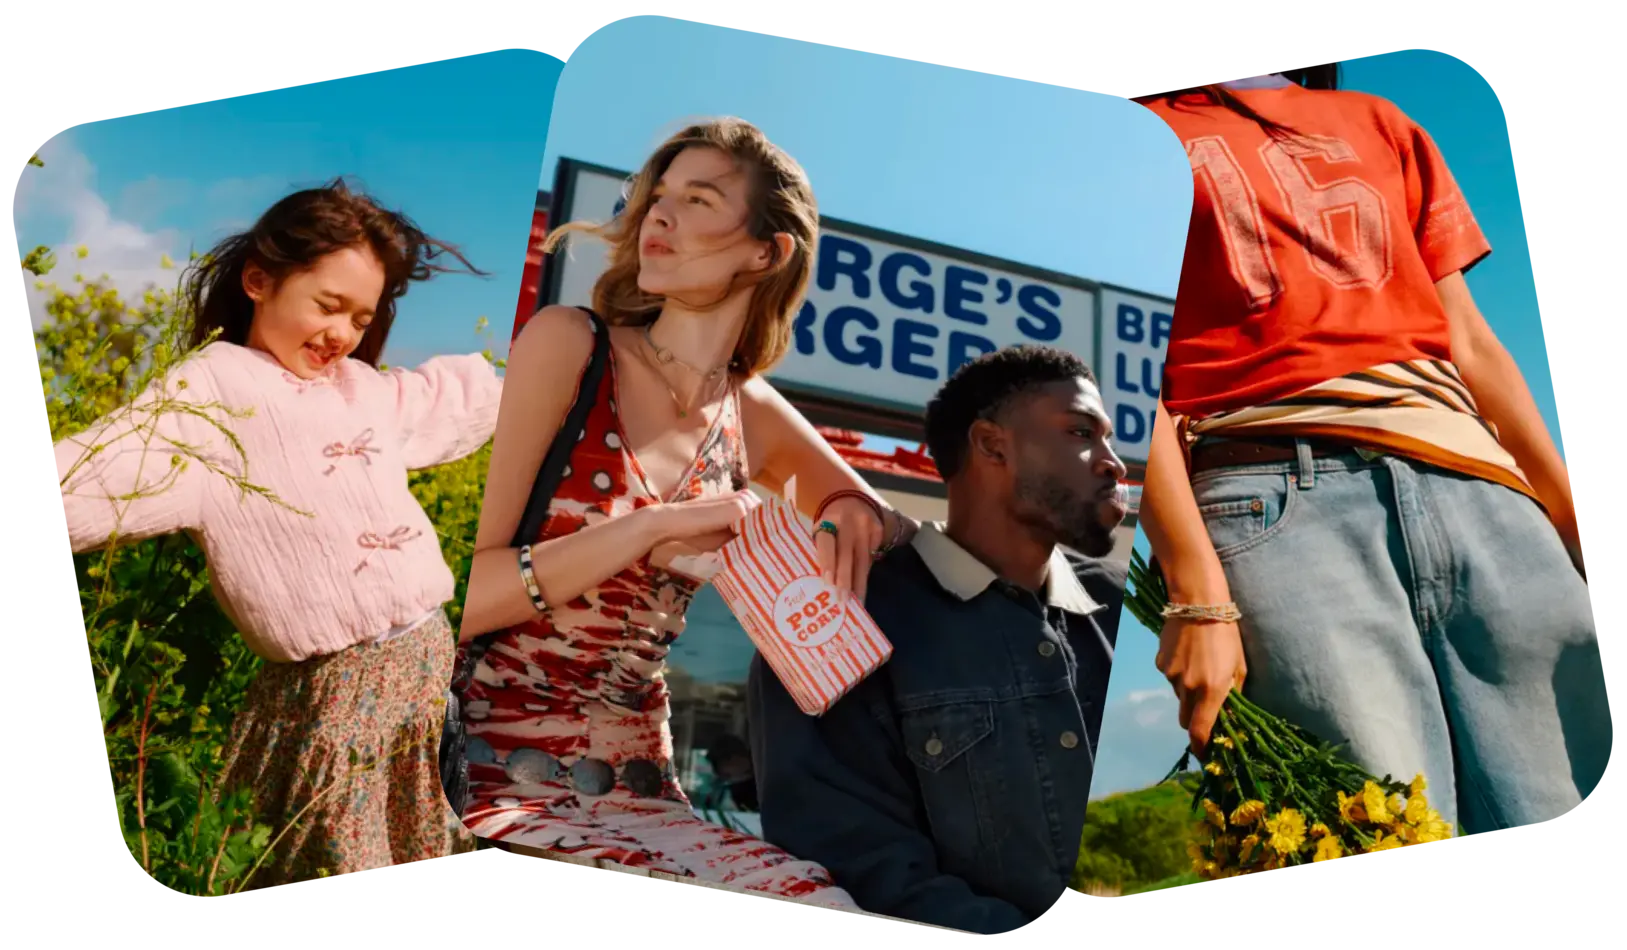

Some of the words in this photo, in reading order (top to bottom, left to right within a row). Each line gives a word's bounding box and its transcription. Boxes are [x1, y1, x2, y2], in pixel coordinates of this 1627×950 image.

[1185, 134, 1393, 309] 16
[792, 299, 1022, 380] RGE
[1116, 352, 1165, 399] LU
[786, 590, 830, 631] POP
[797, 604, 841, 642] CORN
